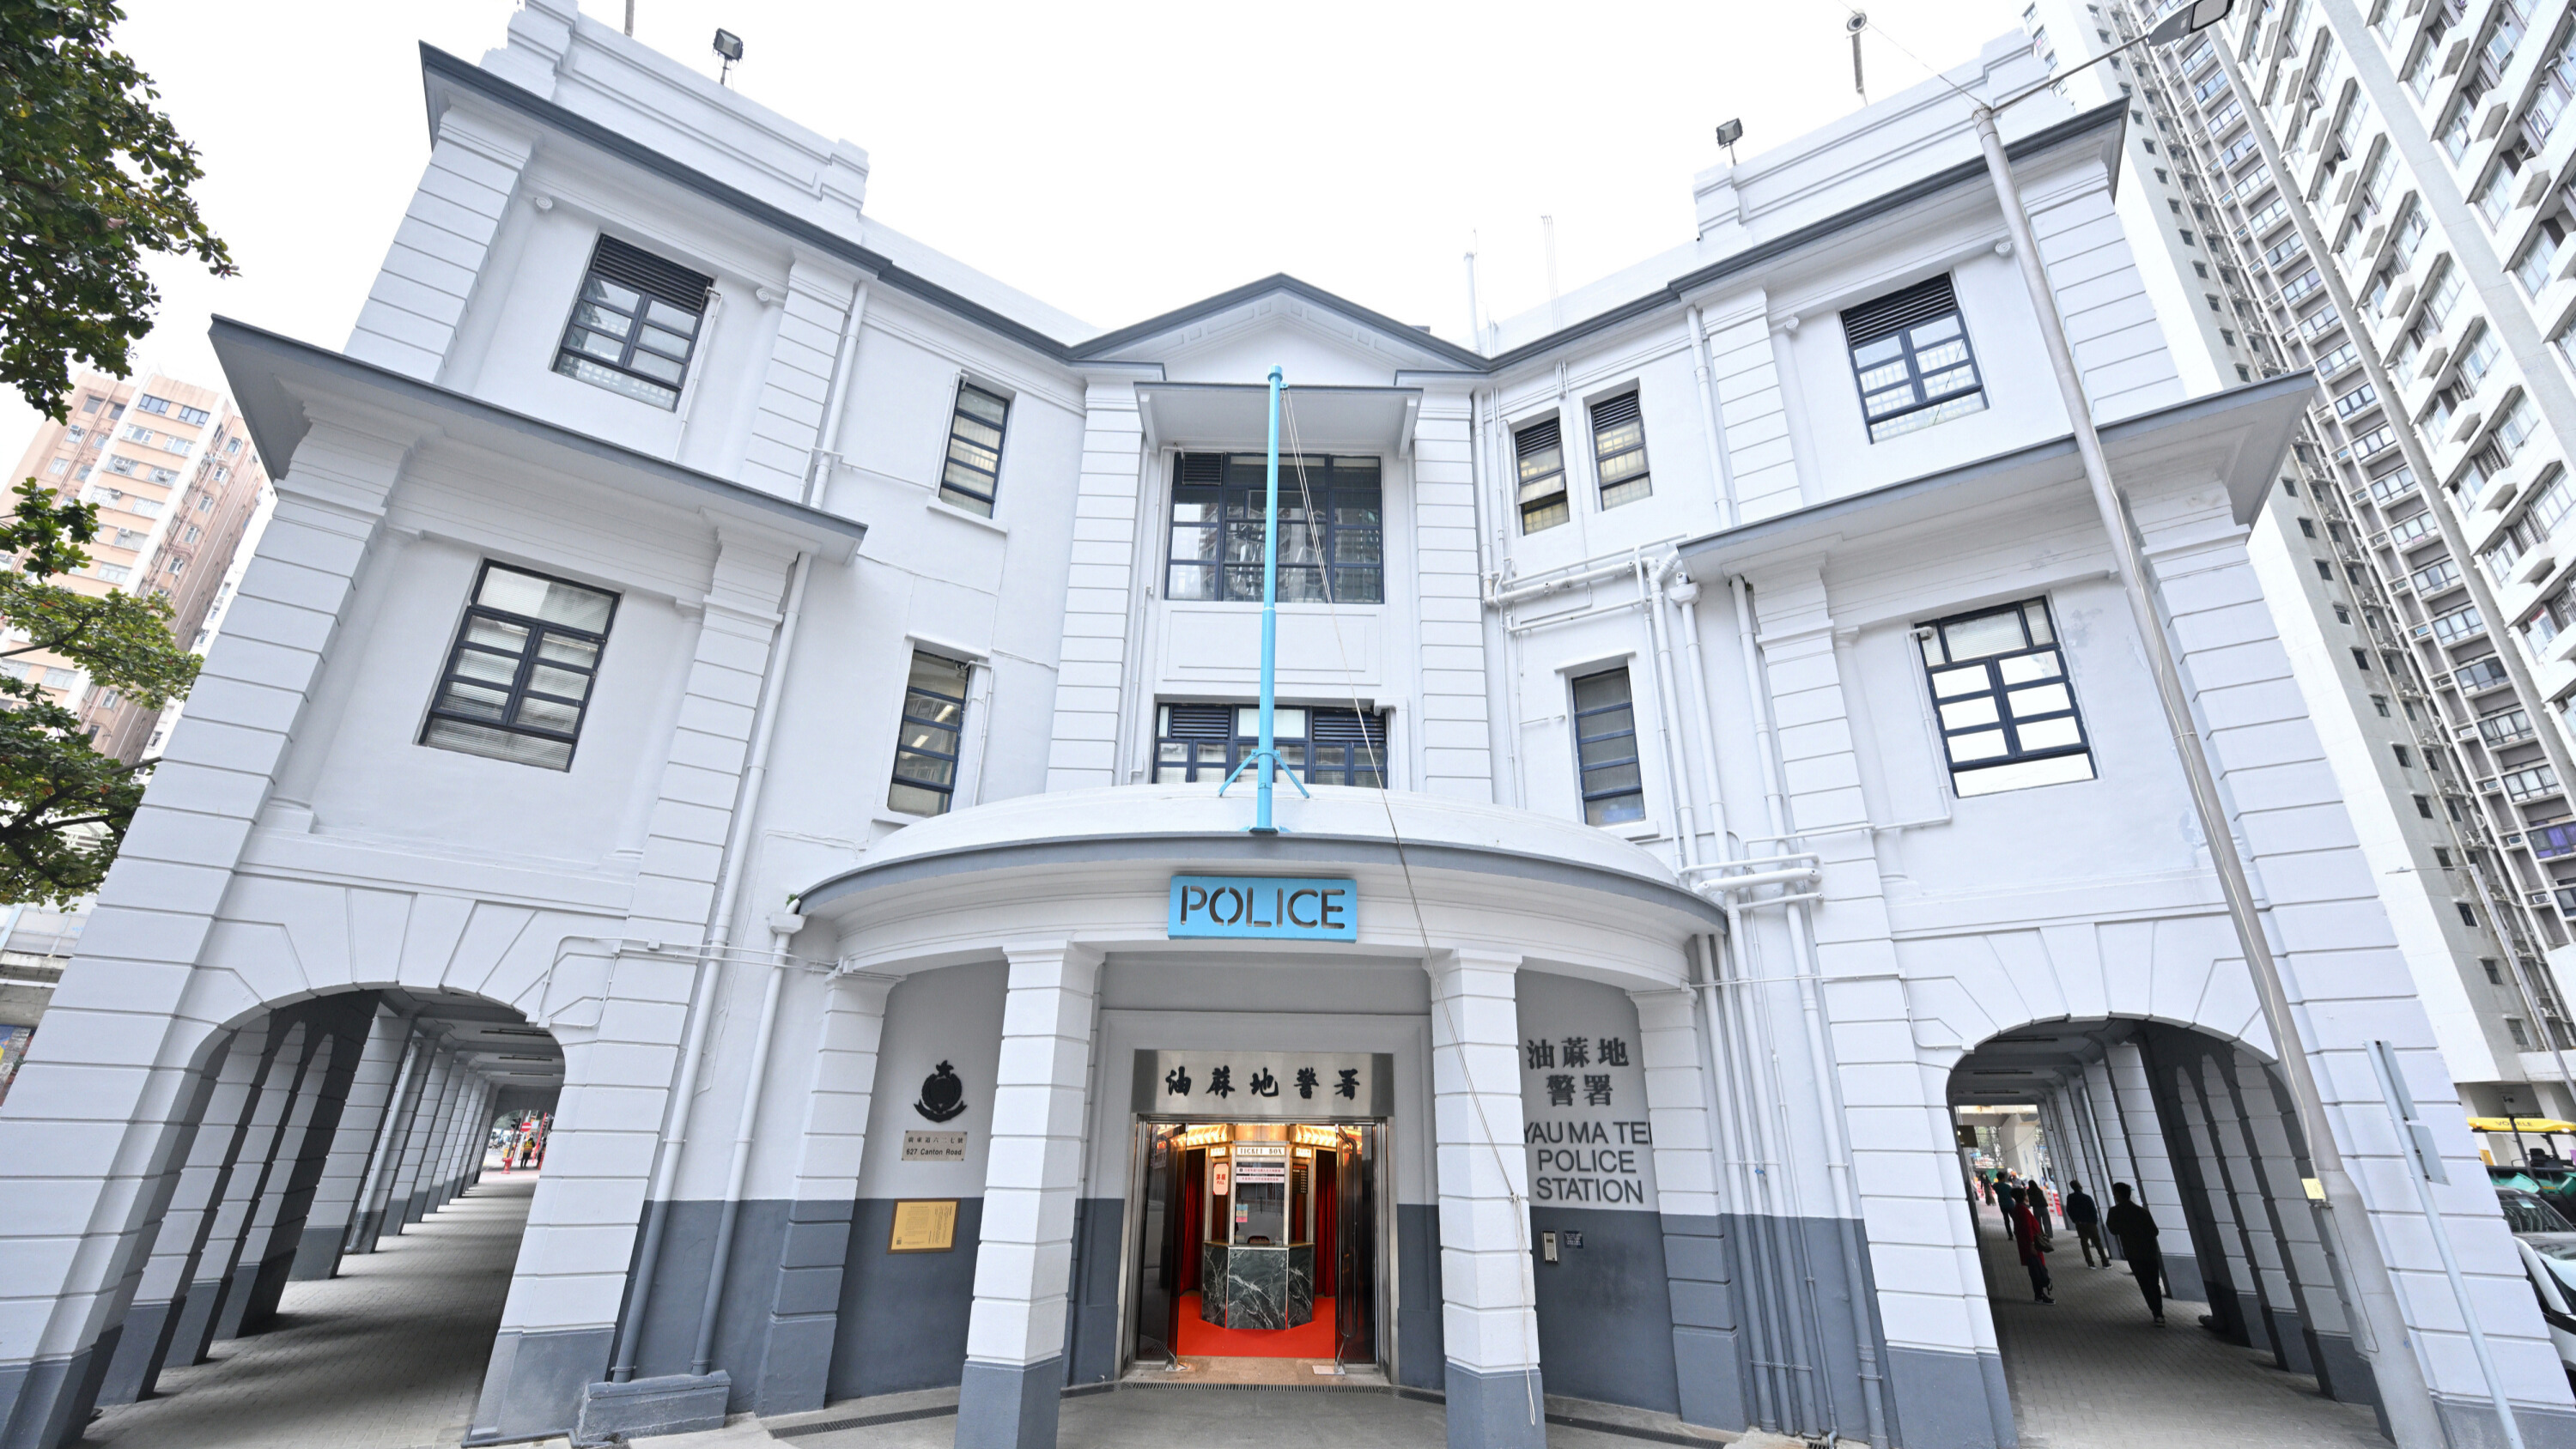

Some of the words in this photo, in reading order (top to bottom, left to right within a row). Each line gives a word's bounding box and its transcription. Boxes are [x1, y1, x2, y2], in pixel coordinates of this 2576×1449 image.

[1180, 885, 1346, 930] POLICE
[1546, 1074, 1613, 1107] 警署
[1568, 1121, 1609, 1144] MA
[1538, 1149, 1637, 1173] POLICE
[1536, 1177, 1644, 1204] STATION
